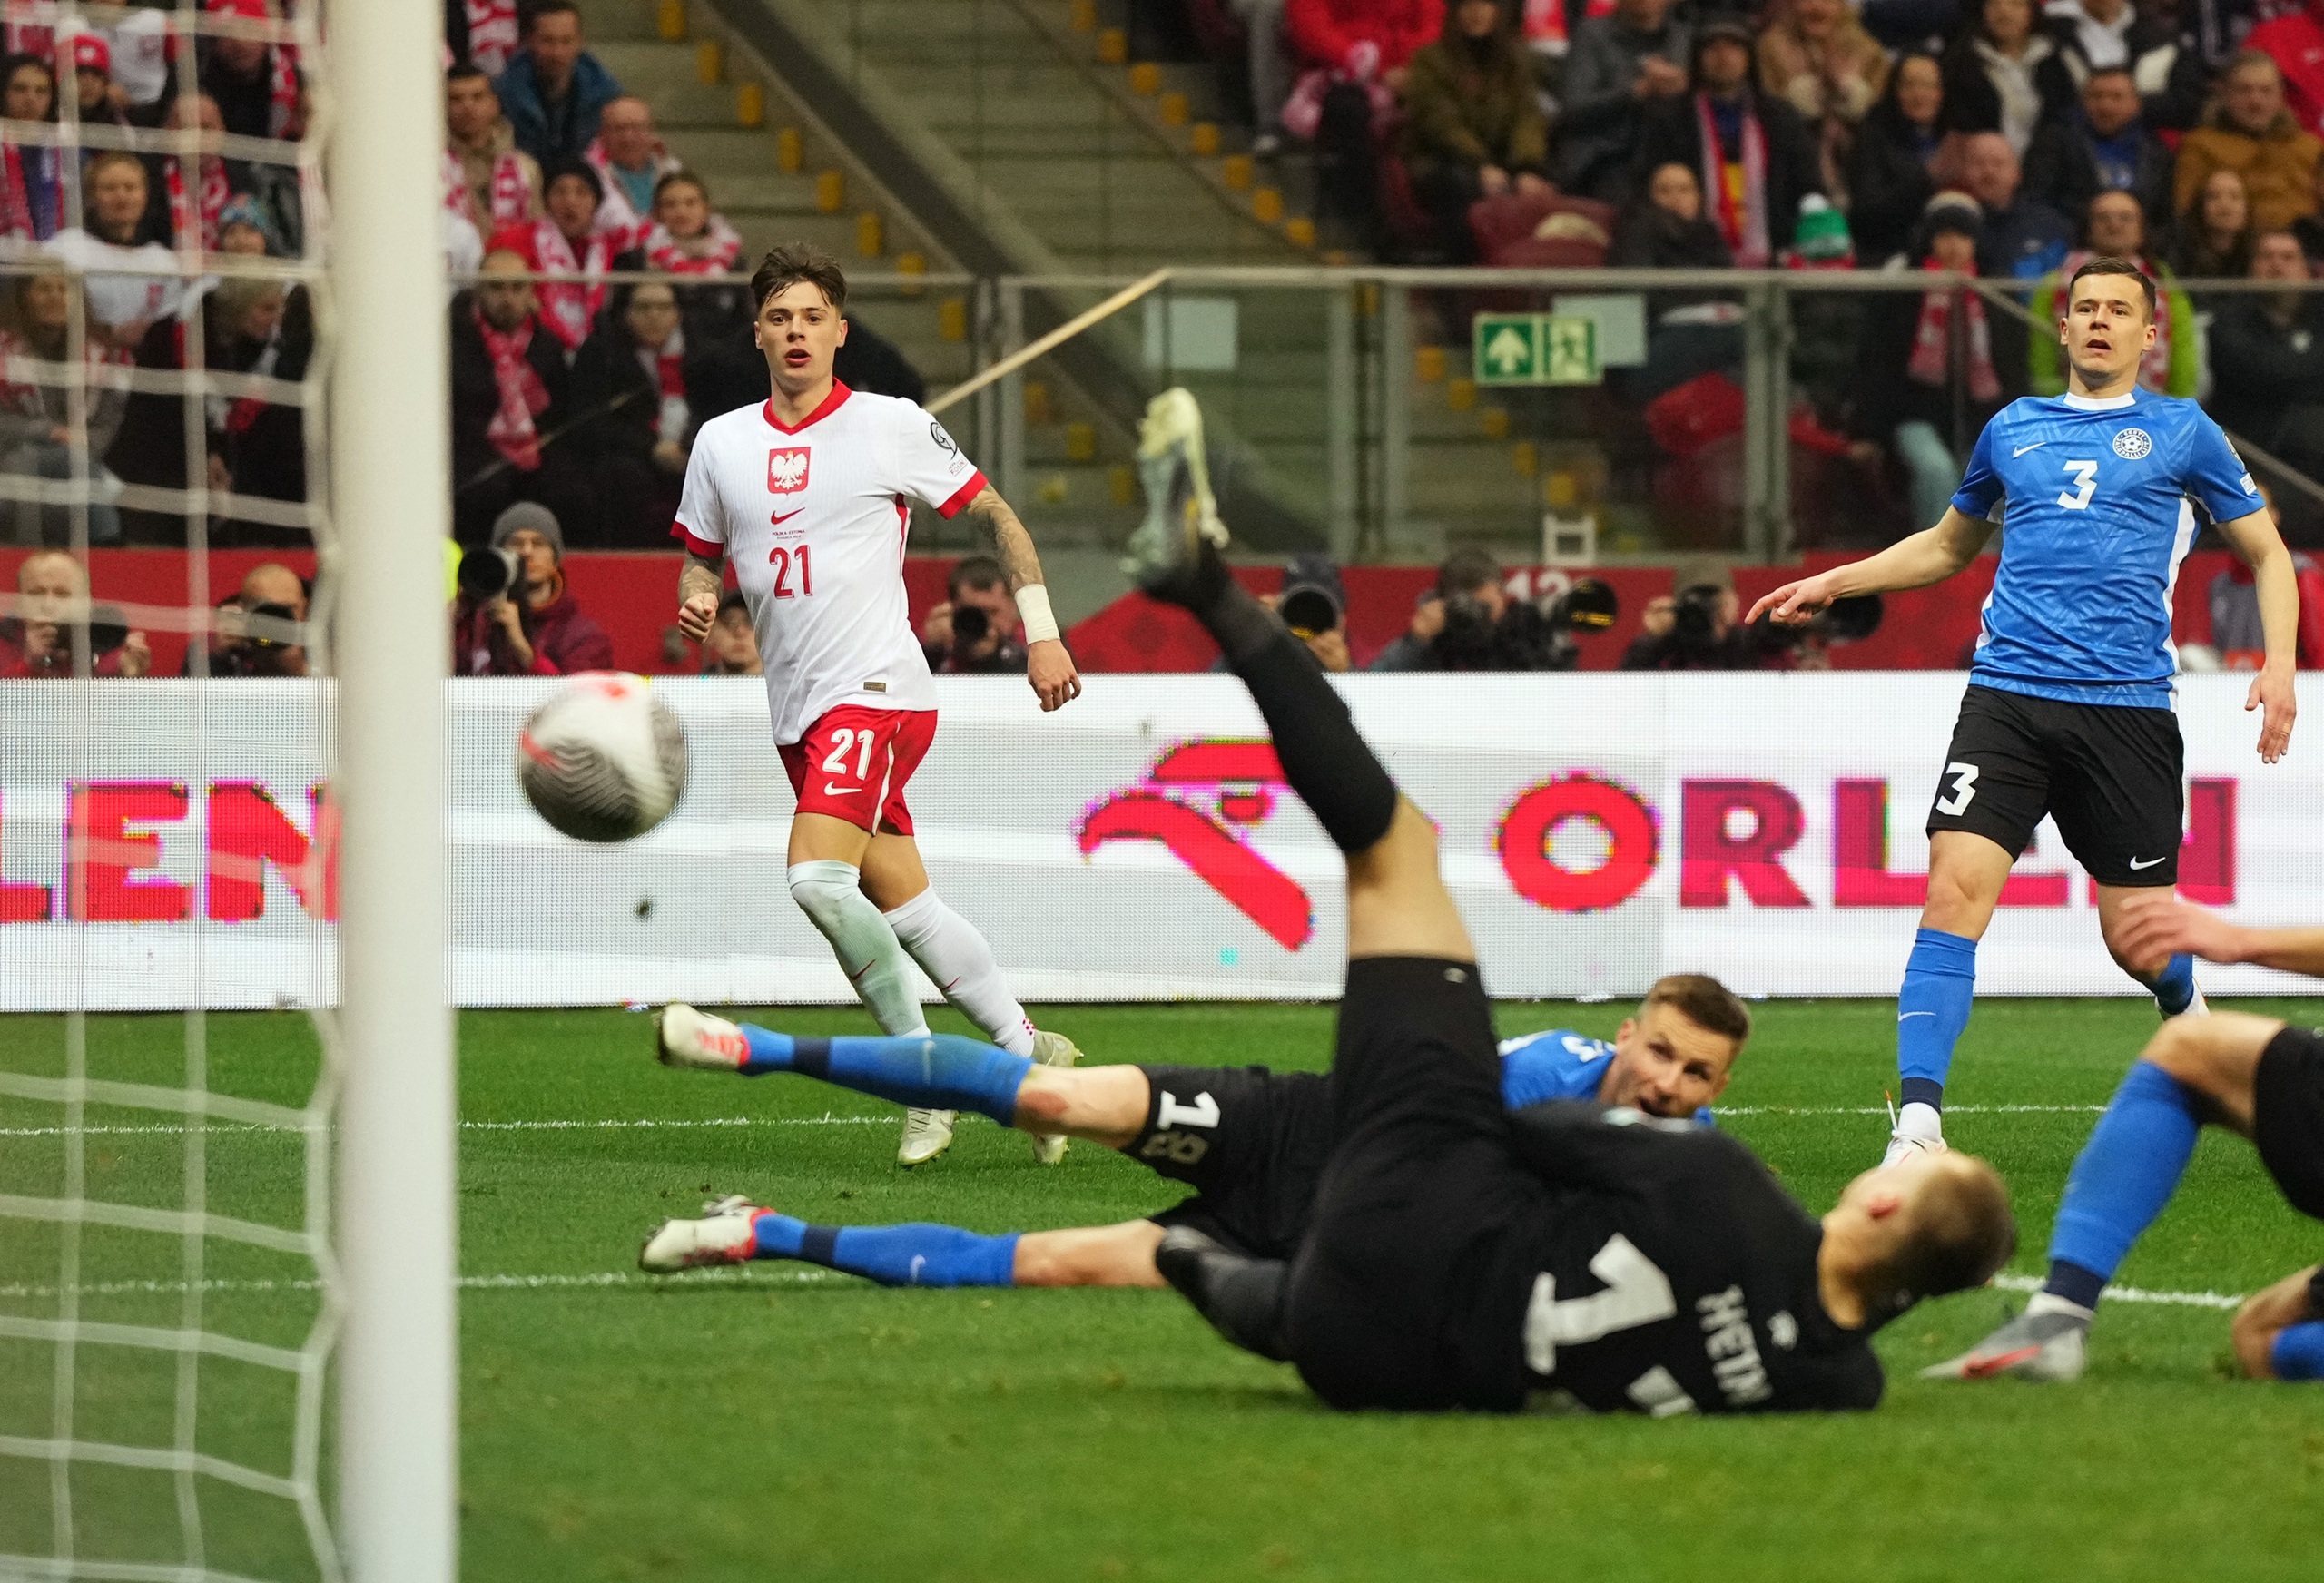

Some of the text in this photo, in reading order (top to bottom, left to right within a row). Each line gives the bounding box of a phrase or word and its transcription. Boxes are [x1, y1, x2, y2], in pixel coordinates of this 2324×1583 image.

[2056, 460, 2098, 510] 3
[769, 545, 812, 599] 21
[822, 728, 875, 781] 21
[1935, 762, 1980, 817] 3
[1492, 771, 2238, 912] ORL
